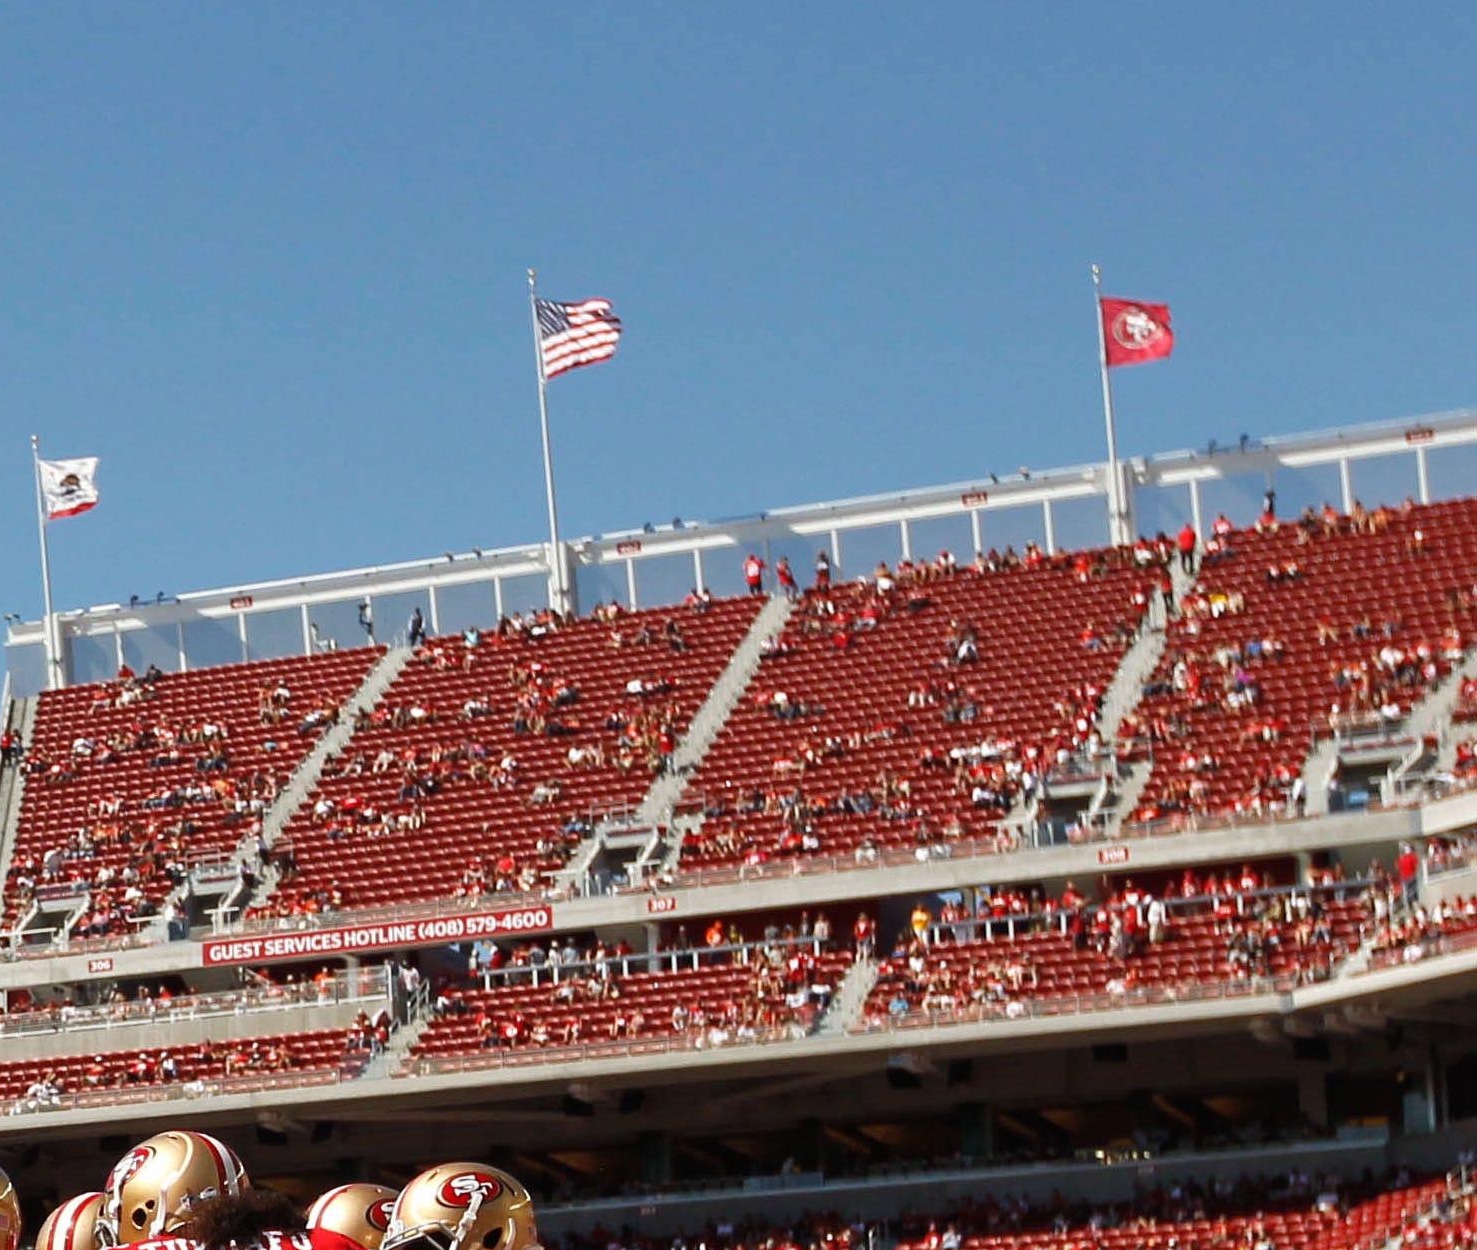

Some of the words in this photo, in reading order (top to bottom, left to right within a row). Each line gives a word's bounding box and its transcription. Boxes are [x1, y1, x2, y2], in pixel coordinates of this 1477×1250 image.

[209, 940, 263, 963] GUEST
[263, 934, 342, 957] SERVICES
[344, 926, 417, 951] HOTLINE
[417, 918, 464, 943] (408)
[465, 909, 548, 937] 579-4600
[89, 959, 112, 972] 306
